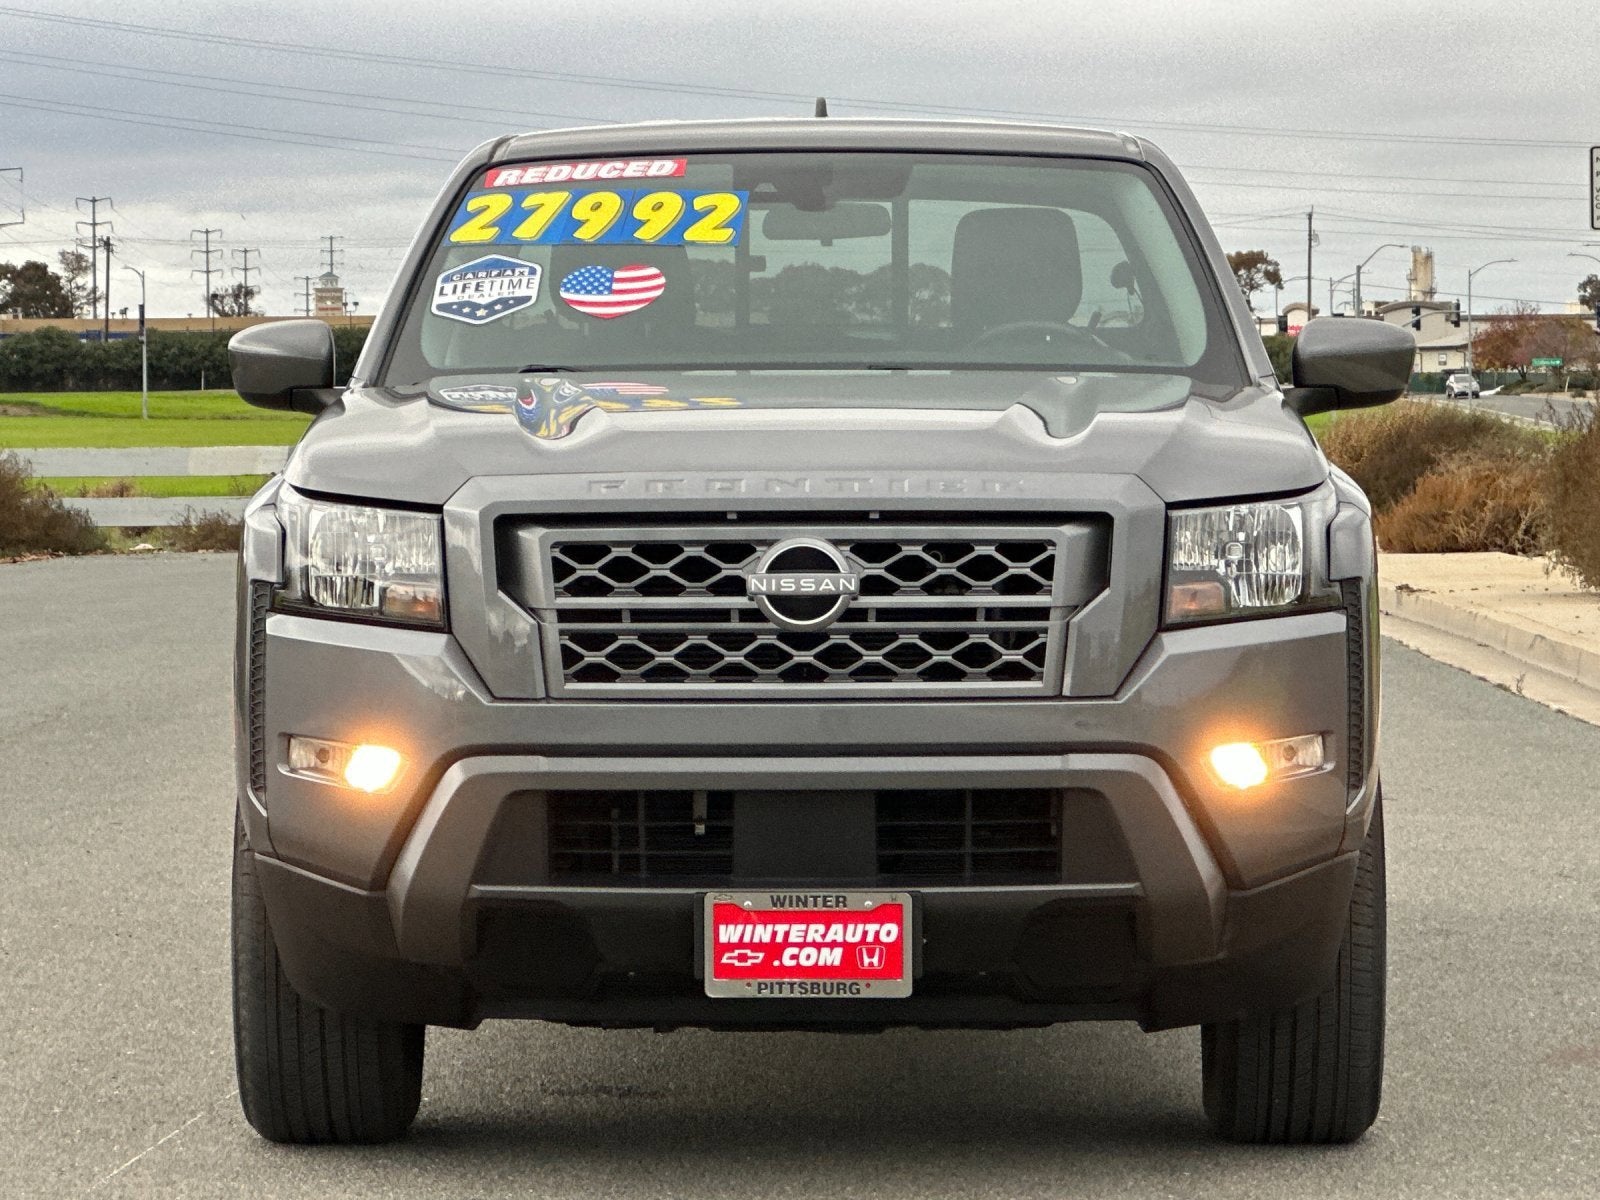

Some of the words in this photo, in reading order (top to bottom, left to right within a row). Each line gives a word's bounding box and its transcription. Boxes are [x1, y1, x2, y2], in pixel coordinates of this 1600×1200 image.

[493, 160, 678, 187] REDUCED
[449, 190, 742, 244] 27992
[451, 268, 528, 282] CARFAX
[438, 277, 536, 297] LIFETIME
[457, 290, 516, 301] DEALER
[587, 476, 1026, 495] FRONTIER
[750, 577, 856, 592] NISSAN
[769, 894, 848, 909] WINTER
[718, 922, 899, 944] WINTERAUTO
[772, 946, 844, 967] .COM
[756, 981, 861, 995] PITTSBURG
